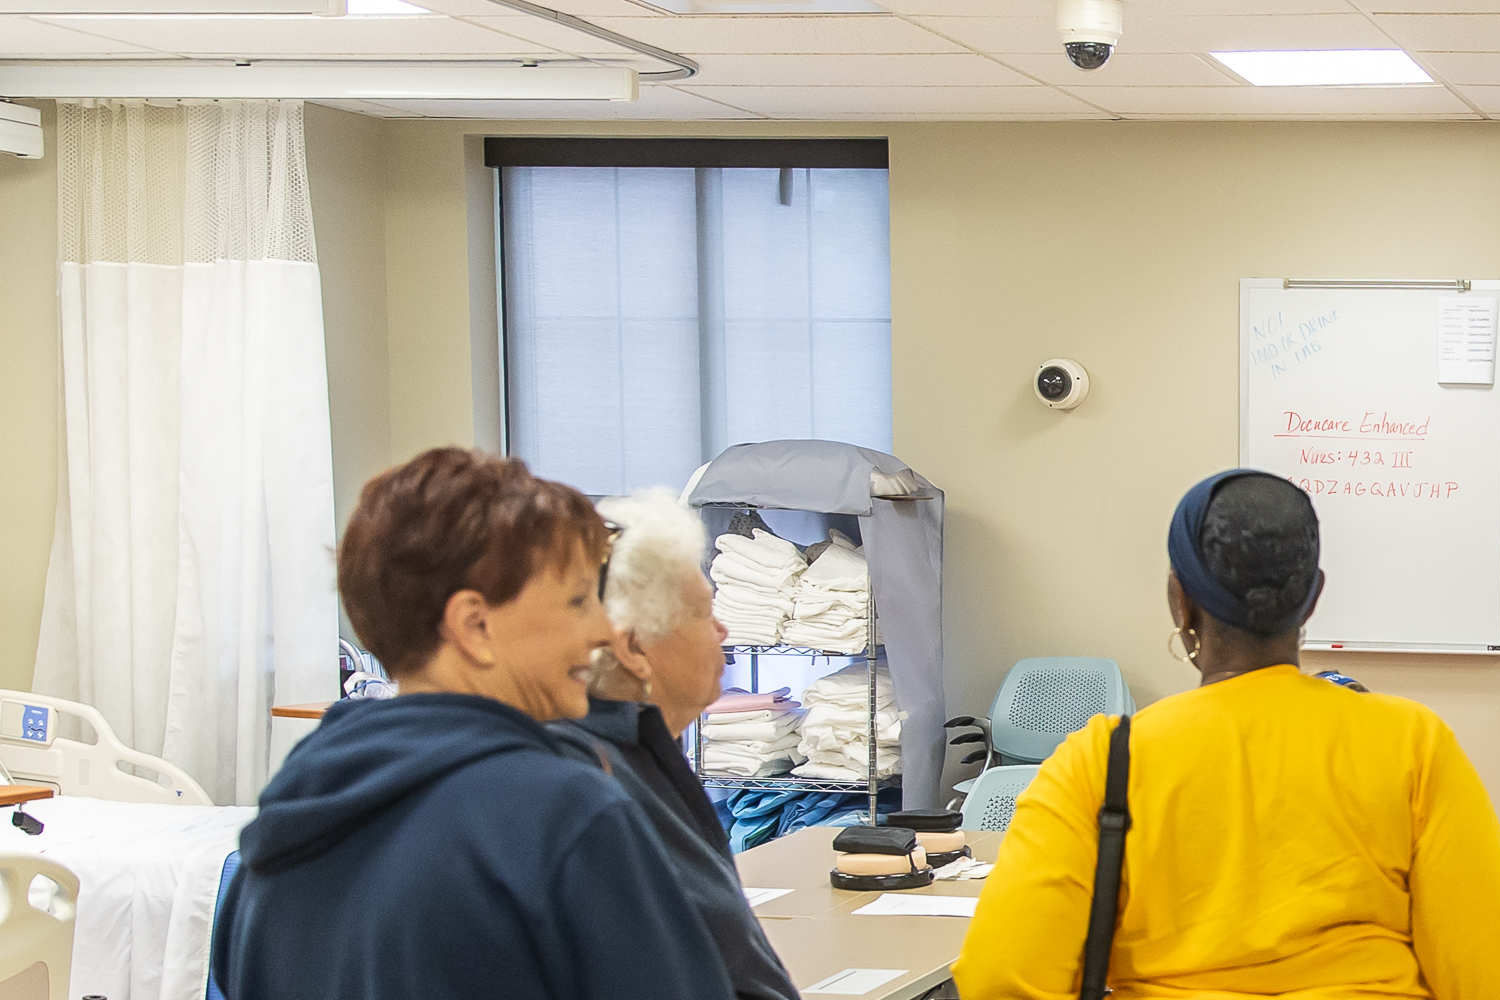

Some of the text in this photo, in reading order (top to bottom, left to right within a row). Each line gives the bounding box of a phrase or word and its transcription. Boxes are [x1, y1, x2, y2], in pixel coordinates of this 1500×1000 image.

[1298, 309, 1341, 341] DRINK
[1271, 359, 1287, 379] IN
[1284, 411, 1430, 436] Docucare Enhanced
[1347, 450, 1384, 466] 432
[1391, 451, 1413, 468] III
